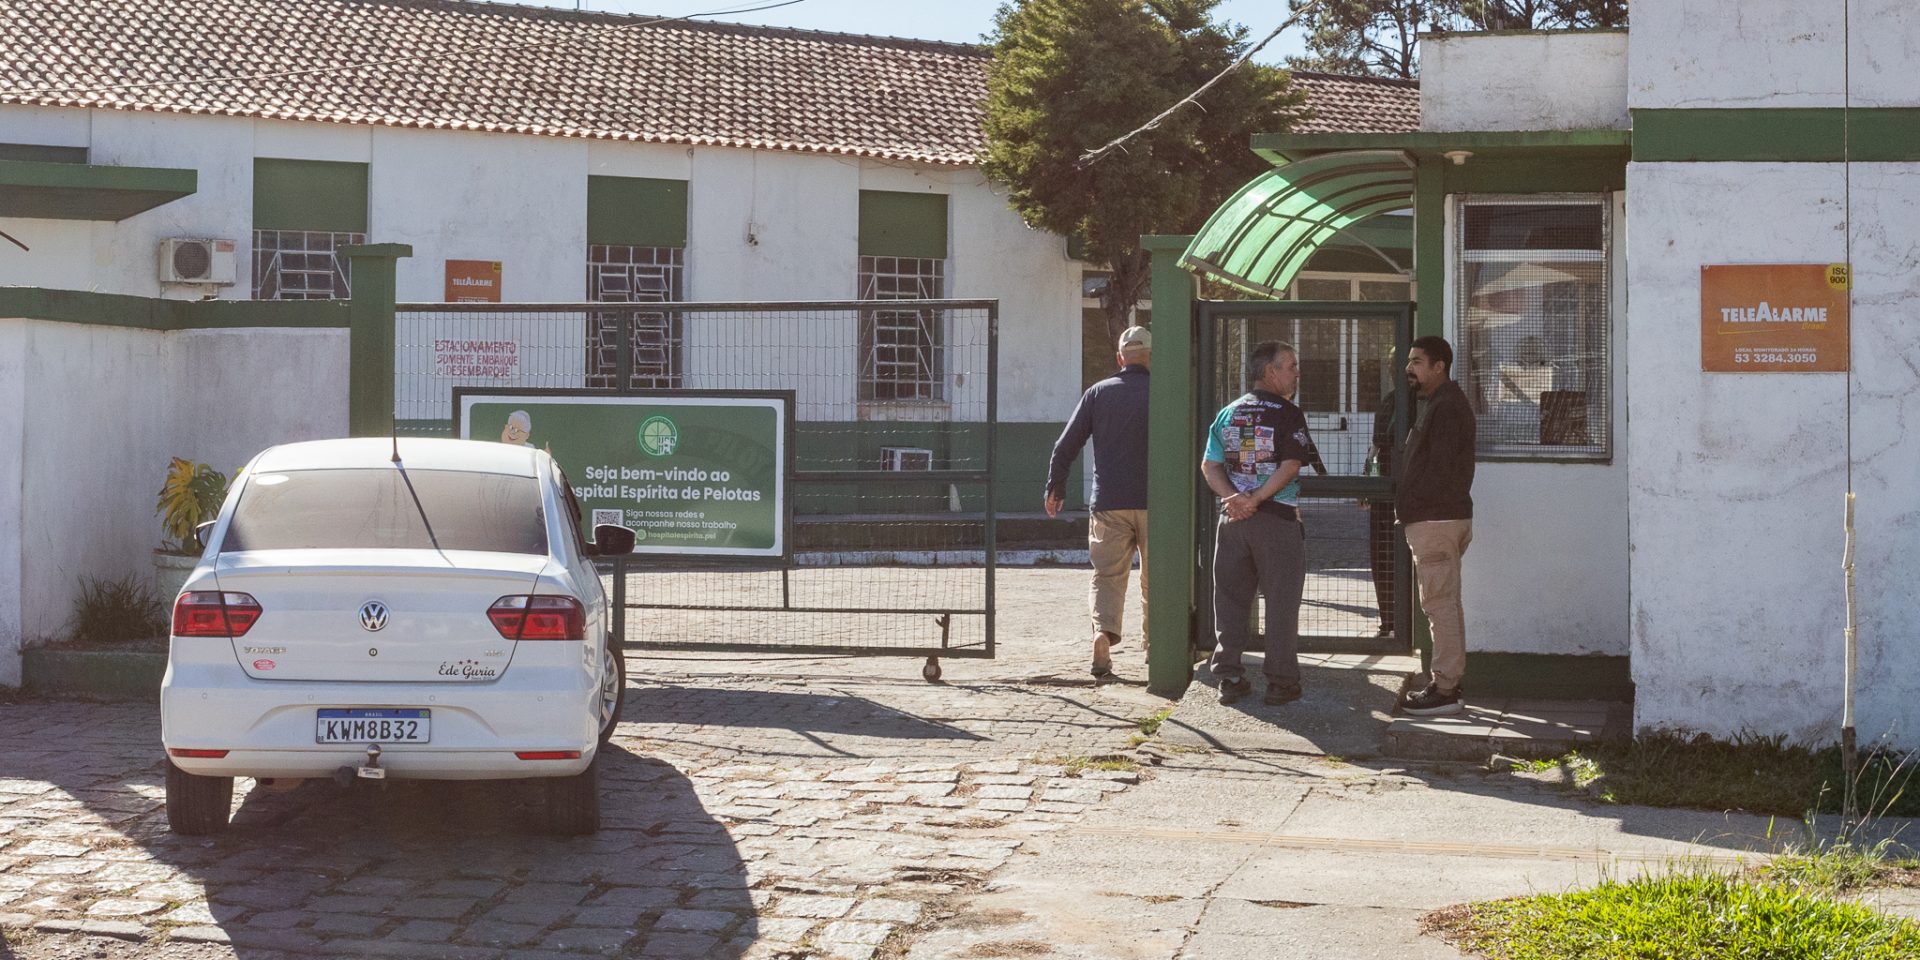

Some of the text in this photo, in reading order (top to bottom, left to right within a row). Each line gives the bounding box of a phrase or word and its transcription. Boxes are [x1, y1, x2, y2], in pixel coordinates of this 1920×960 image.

[1830, 275, 1849, 284] 900
[1720, 301, 1828, 322] TELEALARME
[434, 339, 516, 354] ESTACIONAMENTO
[437, 354, 518, 366] SOMENTE EMBARQUE
[1735, 353, 1817, 363] 53 3284.3050
[446, 365, 510, 377] DESEMBARQUE
[585, 465, 730, 484] Seja bem-vindo ao
[571, 483, 761, 503] spital Espírita de Pelotas
[625, 509, 643, 519] Siga
[675, 510, 698, 519] redes
[625, 520, 674, 530] acompanhe
[701, 520, 737, 530] trabalho
[326, 720, 418, 740] KWM8B32
